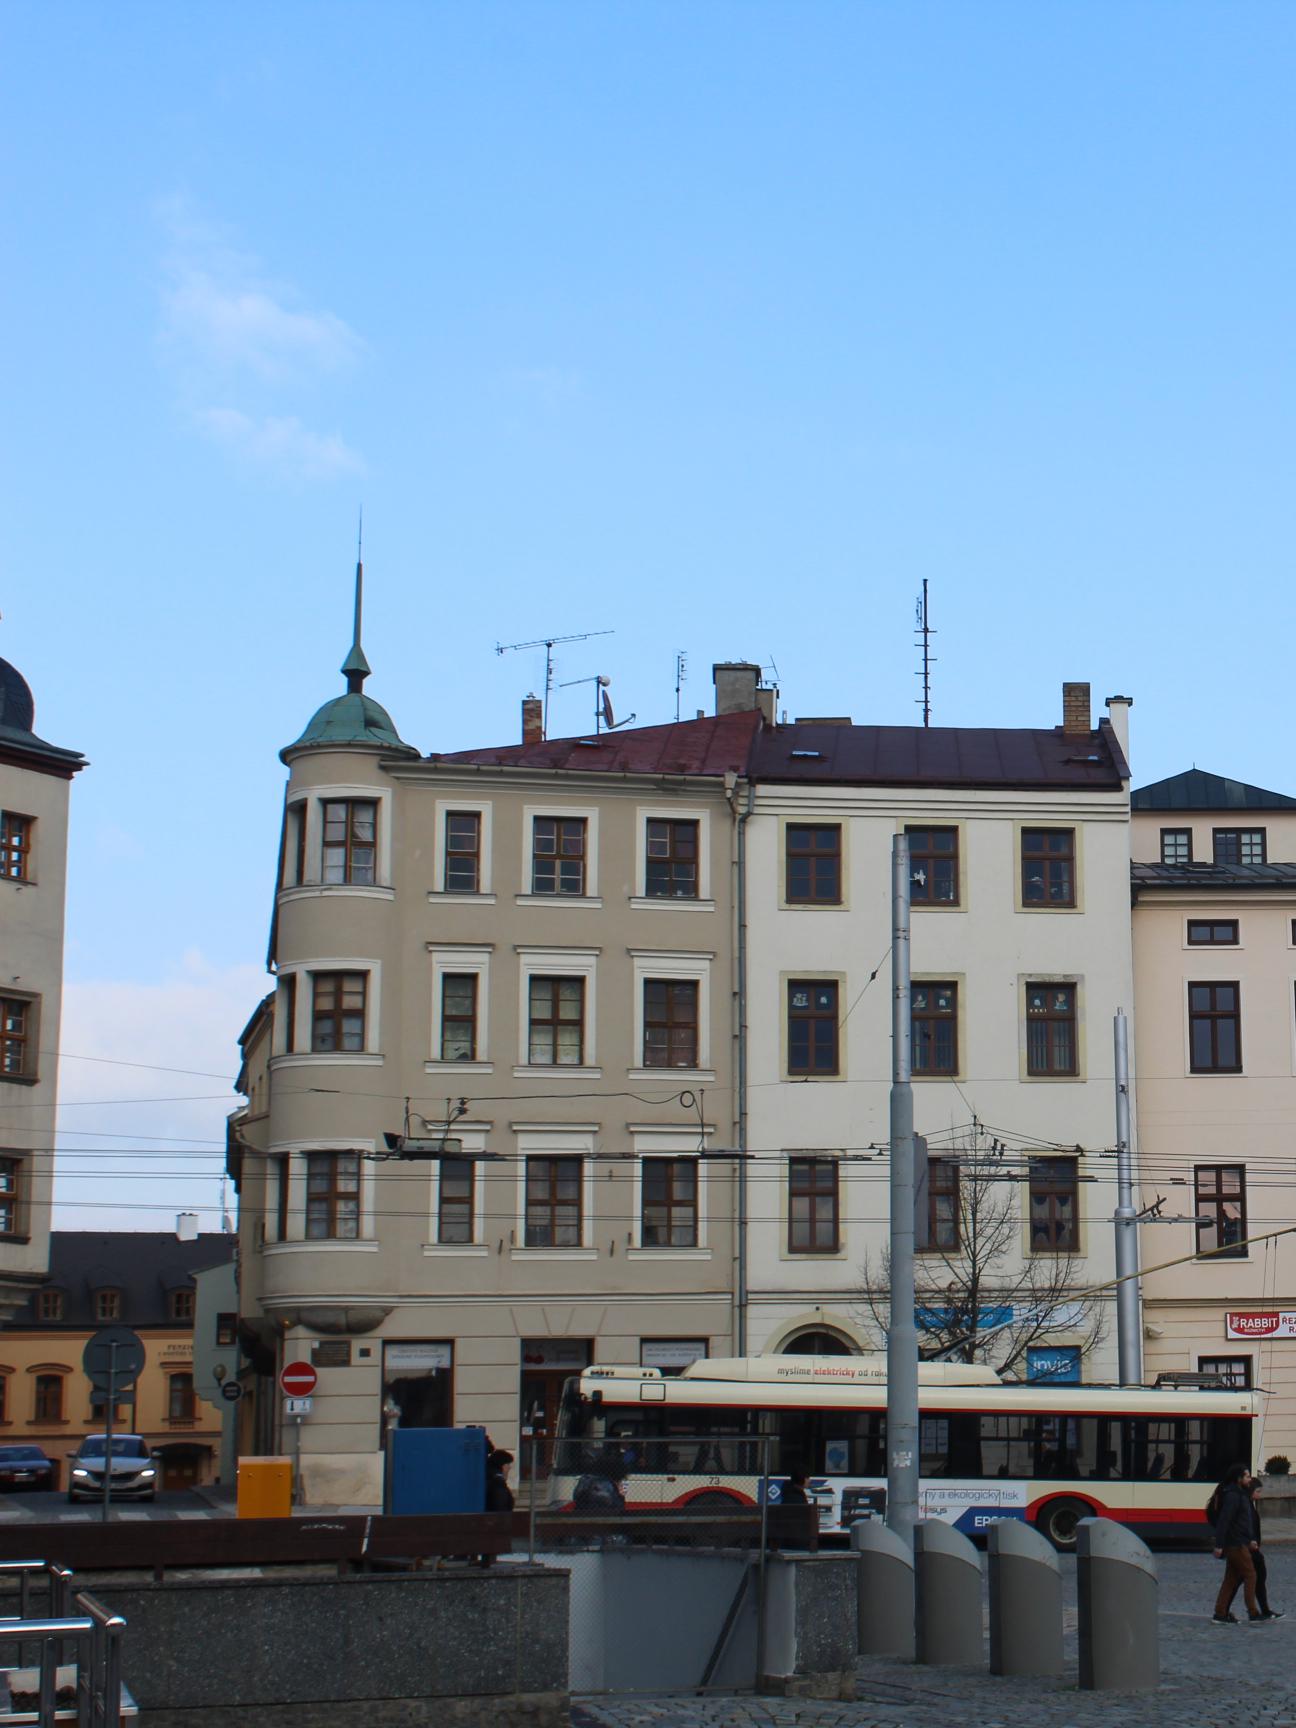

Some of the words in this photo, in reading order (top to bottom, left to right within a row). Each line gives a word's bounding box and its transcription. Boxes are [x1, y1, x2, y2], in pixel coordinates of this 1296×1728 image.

[1240, 1317, 1278, 1328] RABBIT
[1033, 1356, 1072, 1373] invia
[814, 1368, 856, 1378] elektricky
[858, 1369, 869, 1378] od
[939, 1491, 945, 1499] a
[1002, 1490, 1019, 1500] tisk
